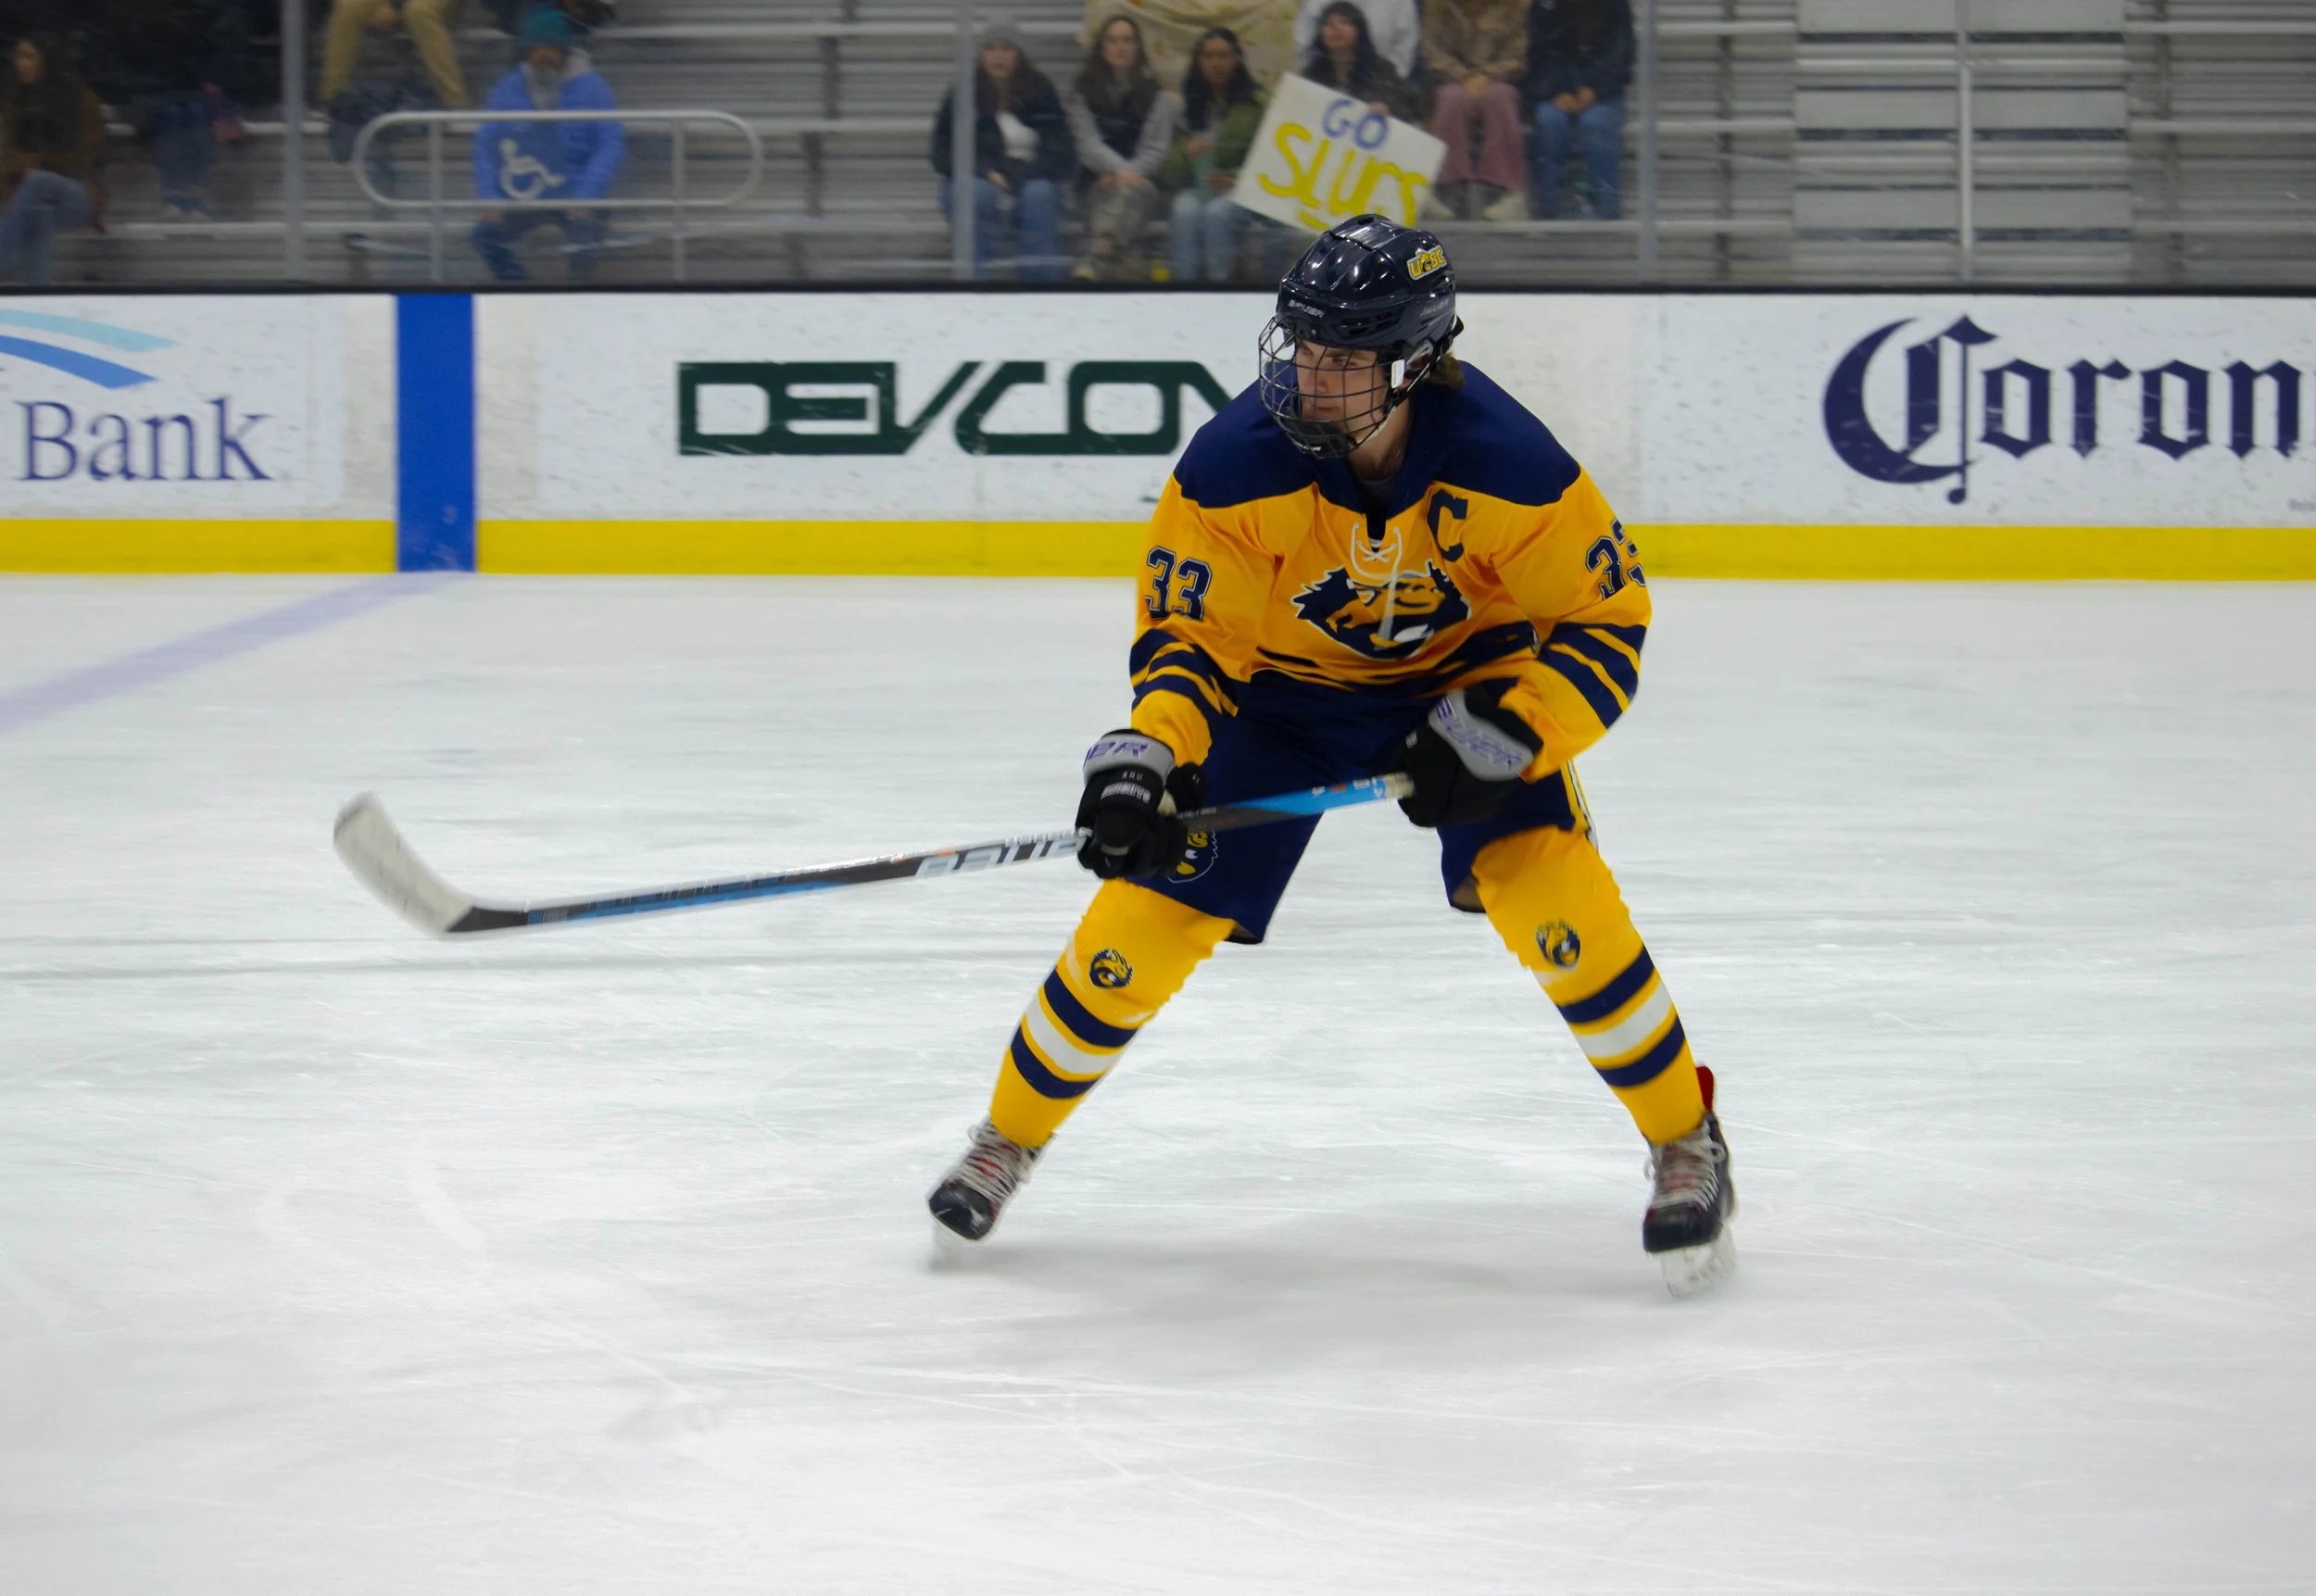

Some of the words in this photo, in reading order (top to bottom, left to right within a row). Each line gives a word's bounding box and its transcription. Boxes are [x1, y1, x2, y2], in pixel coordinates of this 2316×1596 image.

[1322, 98, 1389, 150] GO
[15, 396, 274, 481] Bank
[1822, 315, 2316, 505] Coron
[1427, 488, 1468, 562] C
[1144, 546, 1213, 622] 33
